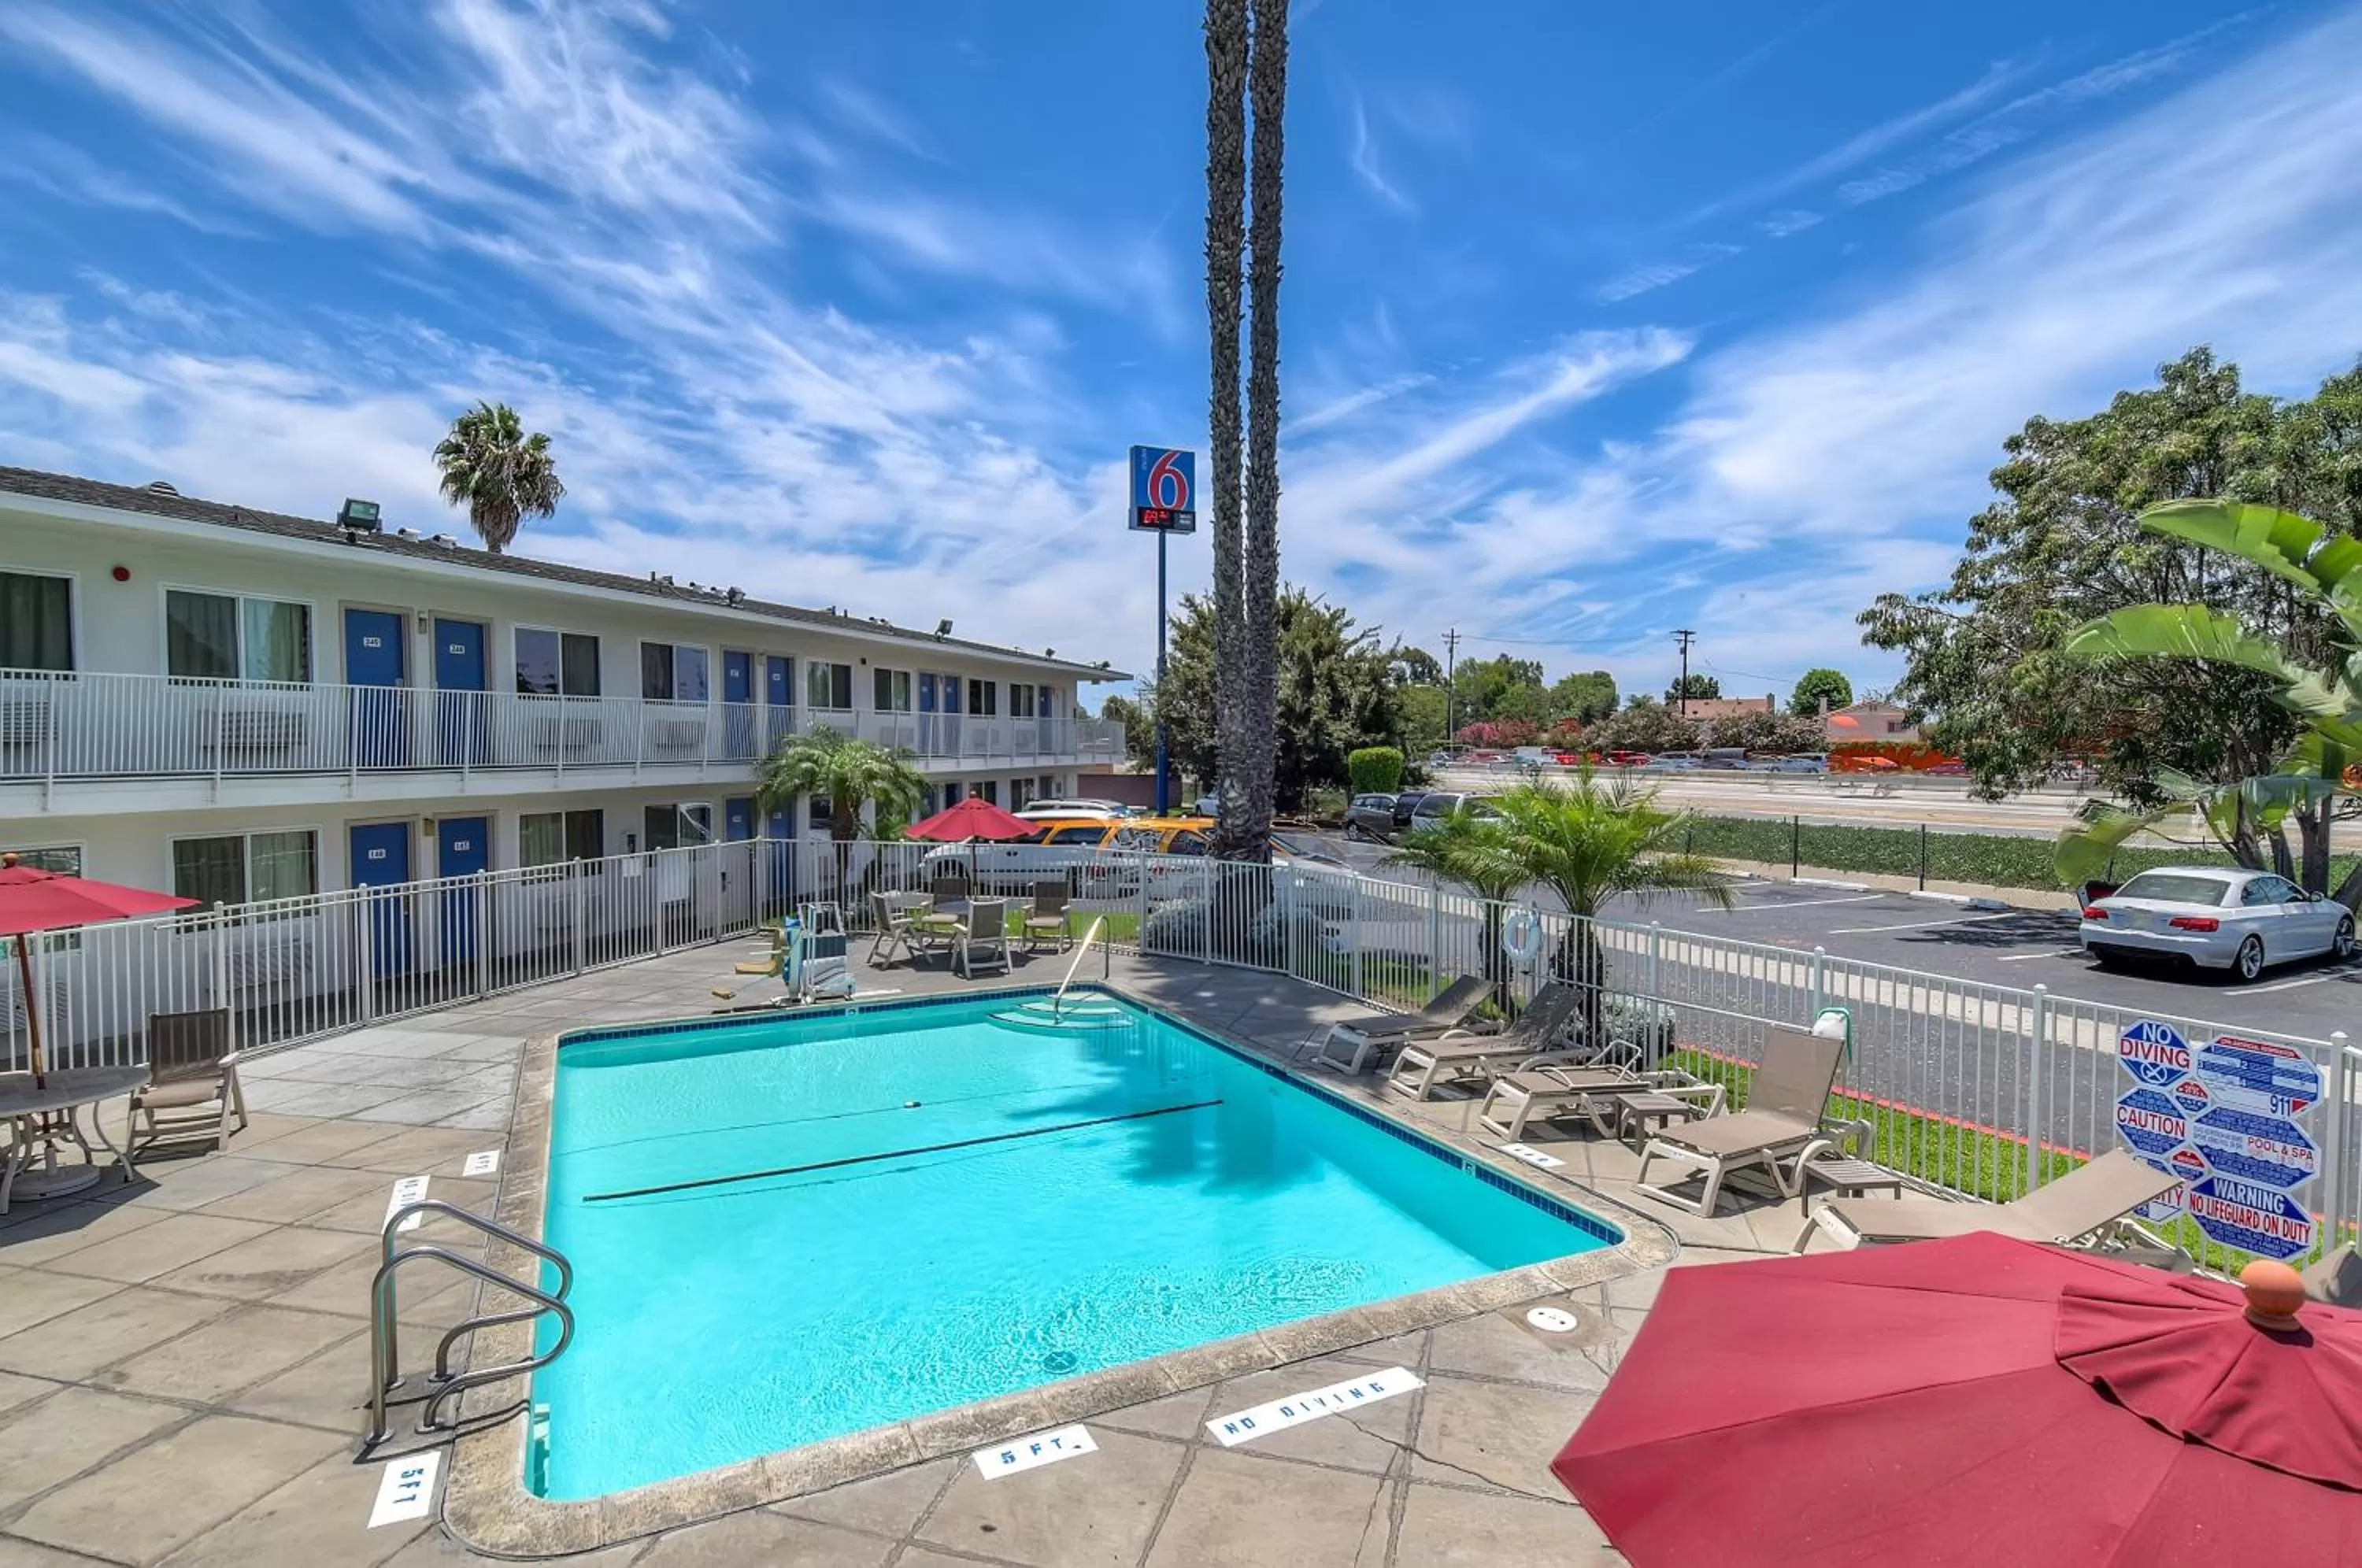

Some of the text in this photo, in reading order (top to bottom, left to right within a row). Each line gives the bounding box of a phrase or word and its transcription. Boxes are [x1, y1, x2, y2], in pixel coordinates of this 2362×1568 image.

[1148, 449, 1189, 510] 6
[2142, 1023, 2172, 1045] NO
[2120, 1038, 2190, 1069] DIVING
[2270, 1095, 2290, 1116] 911
[2117, 1106, 2185, 1137] CAUTION
[2248, 1136, 2279, 1153] POOL
[2281, 1148, 2289, 1156] &
[2291, 1147, 2313, 1160] SPA
[2213, 1177, 2284, 1215] WARNING
[2190, 1193, 2204, 1213] NO
[2207, 1198, 2260, 1229] LIFEGUARD
[2264, 1213, 2279, 1235] ON
[2282, 1219, 2311, 1244] DUTY
[1224, 1381, 1386, 1435] NO DIVING
